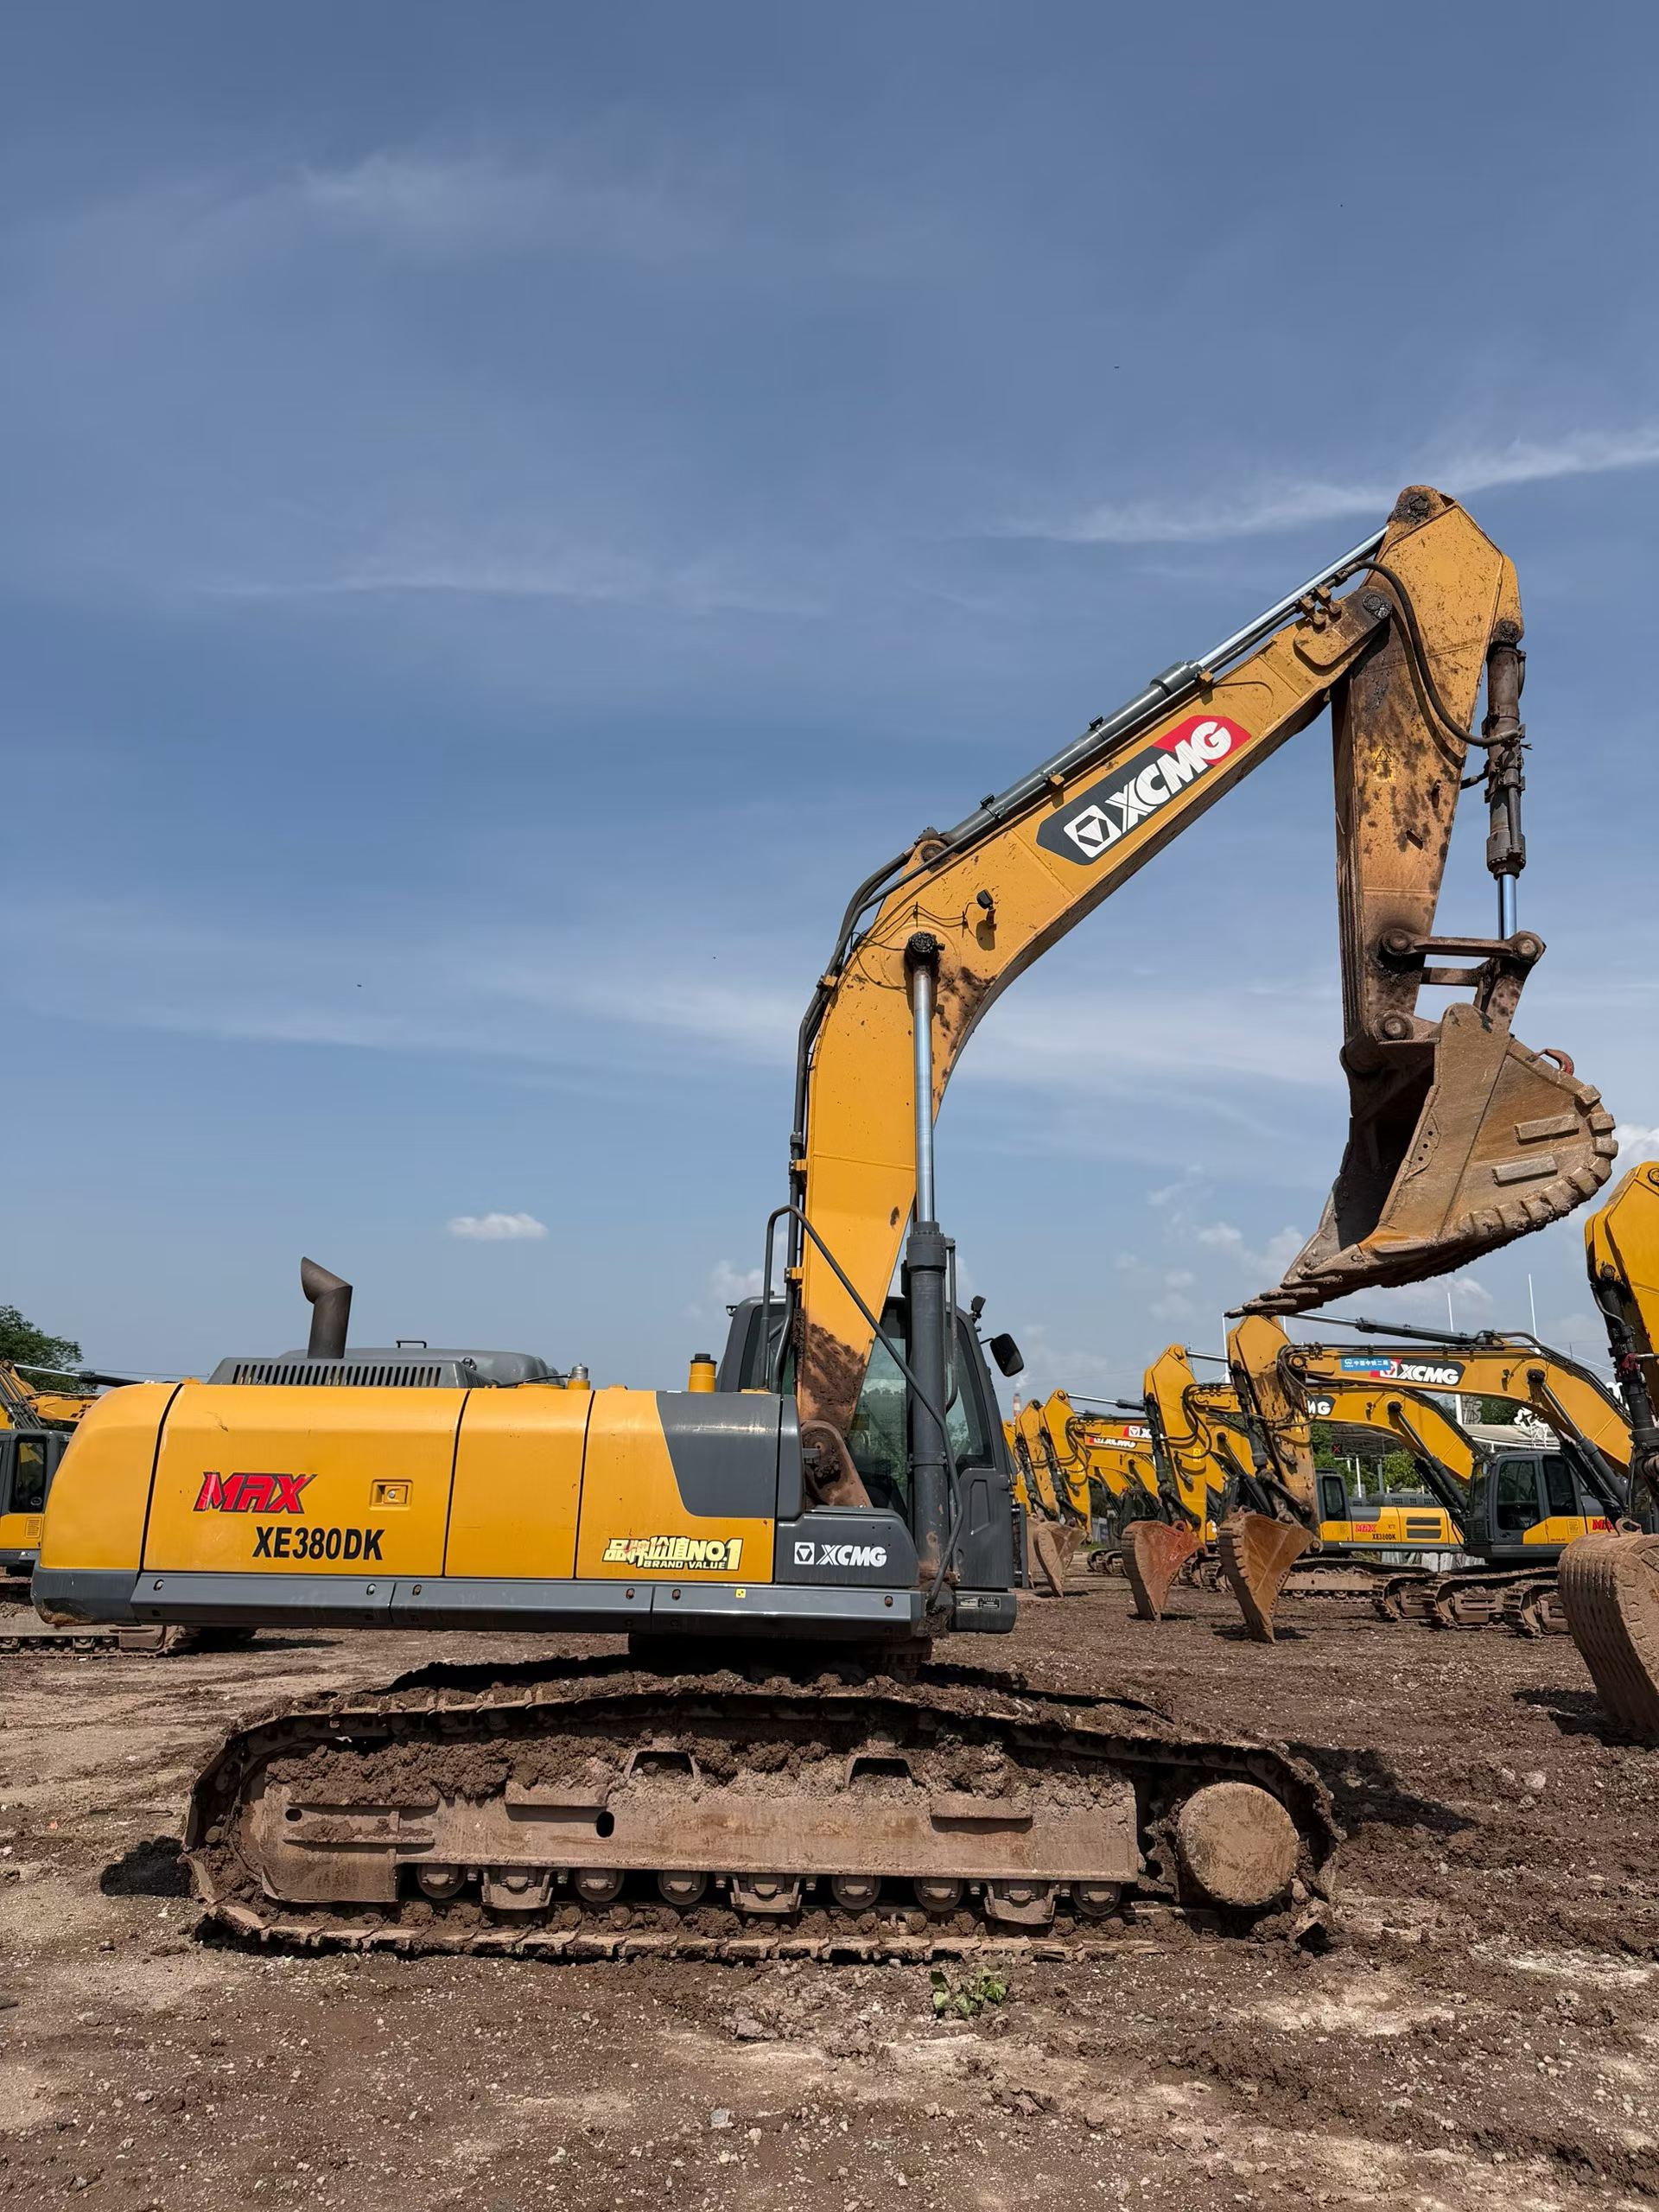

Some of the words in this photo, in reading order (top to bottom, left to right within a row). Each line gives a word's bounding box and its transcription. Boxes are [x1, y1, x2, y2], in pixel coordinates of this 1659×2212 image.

[1104, 721, 1232, 834] XCMG
[1397, 1363, 1459, 1385] XCMG
[1306, 1400, 1332, 1415] MG
[193, 1471, 318, 1514] MAX
[252, 1526, 385, 1560] XE380DK
[816, 1543, 887, 1567] XCMG
